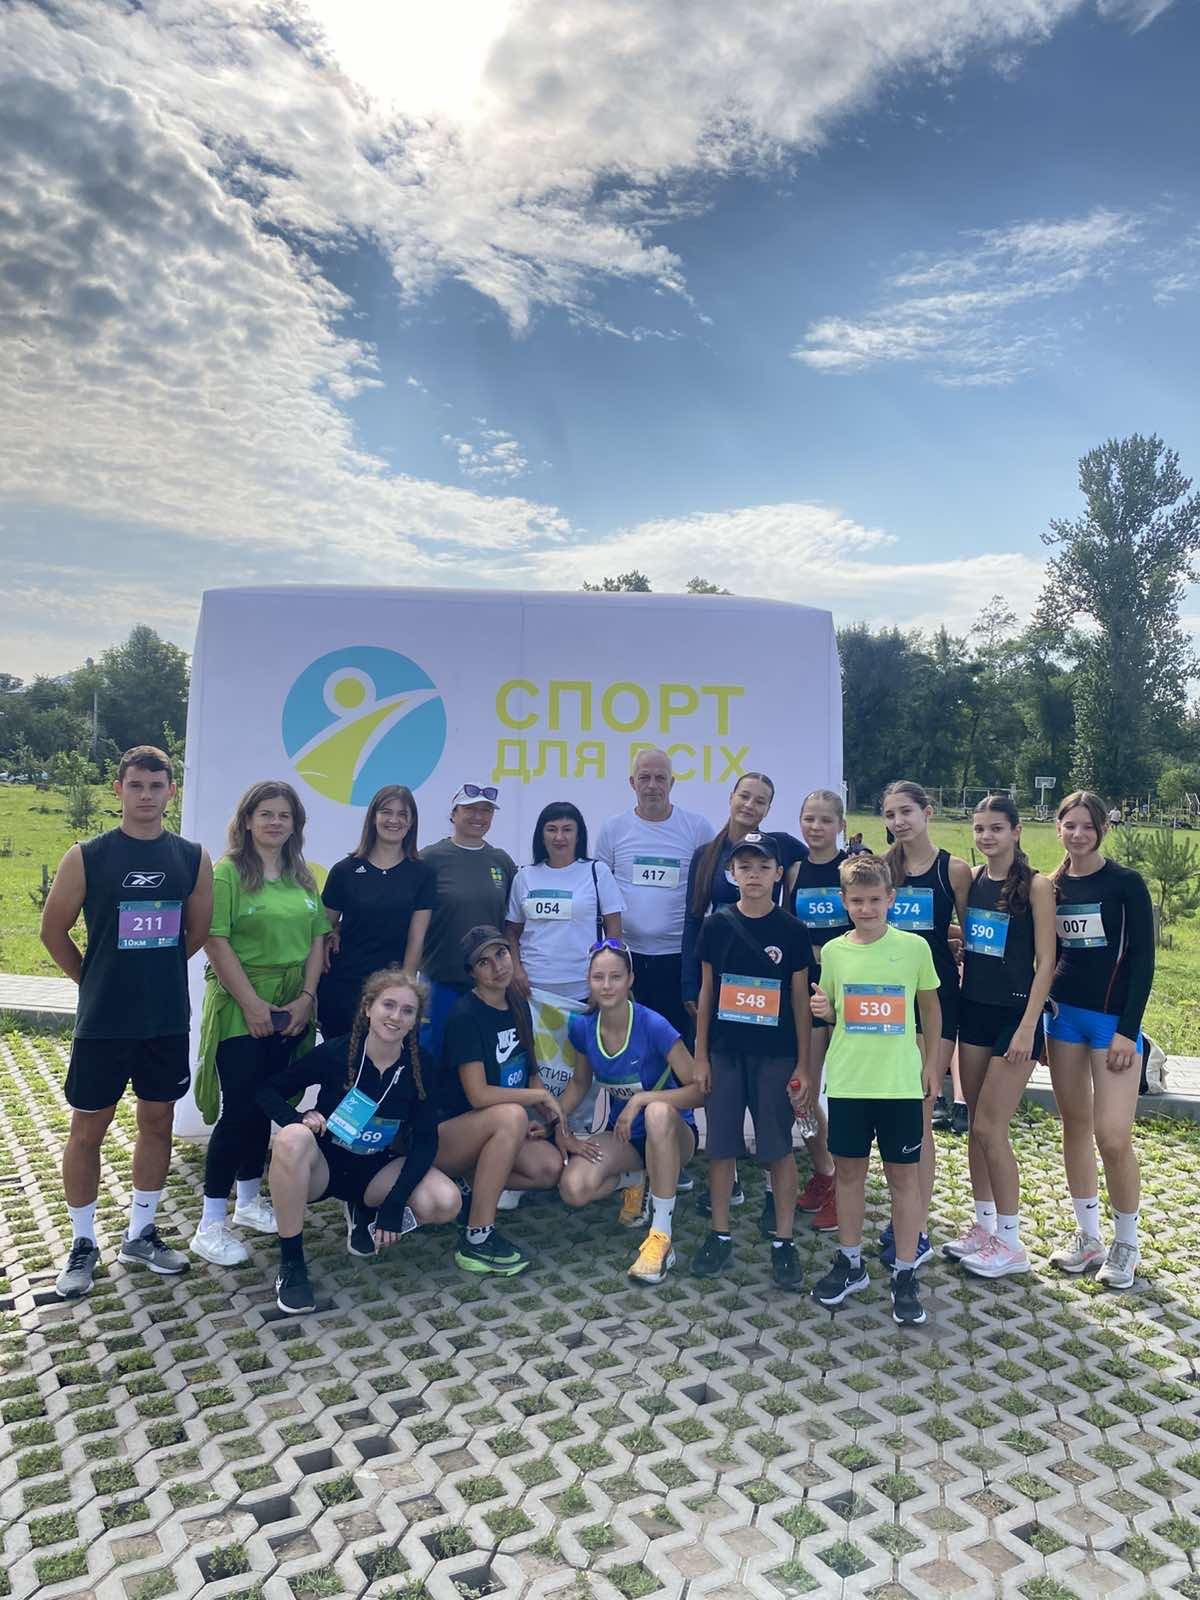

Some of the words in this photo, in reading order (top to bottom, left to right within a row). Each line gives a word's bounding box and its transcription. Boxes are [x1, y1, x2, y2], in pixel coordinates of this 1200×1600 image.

[495, 679, 745, 736] СПОРТ
[491, 739, 606, 784] ДЛЯ
[642, 869, 666, 881] 417
[535, 902, 560, 914] 054
[808, 902, 834, 914] 563
[893, 903, 921, 915] 574
[133, 916, 163, 931] 211
[1063, 920, 1088, 933] 007
[970, 924, 994, 939] 590
[735, 992, 766, 1008] 548
[859, 1002, 891, 1016] 530
